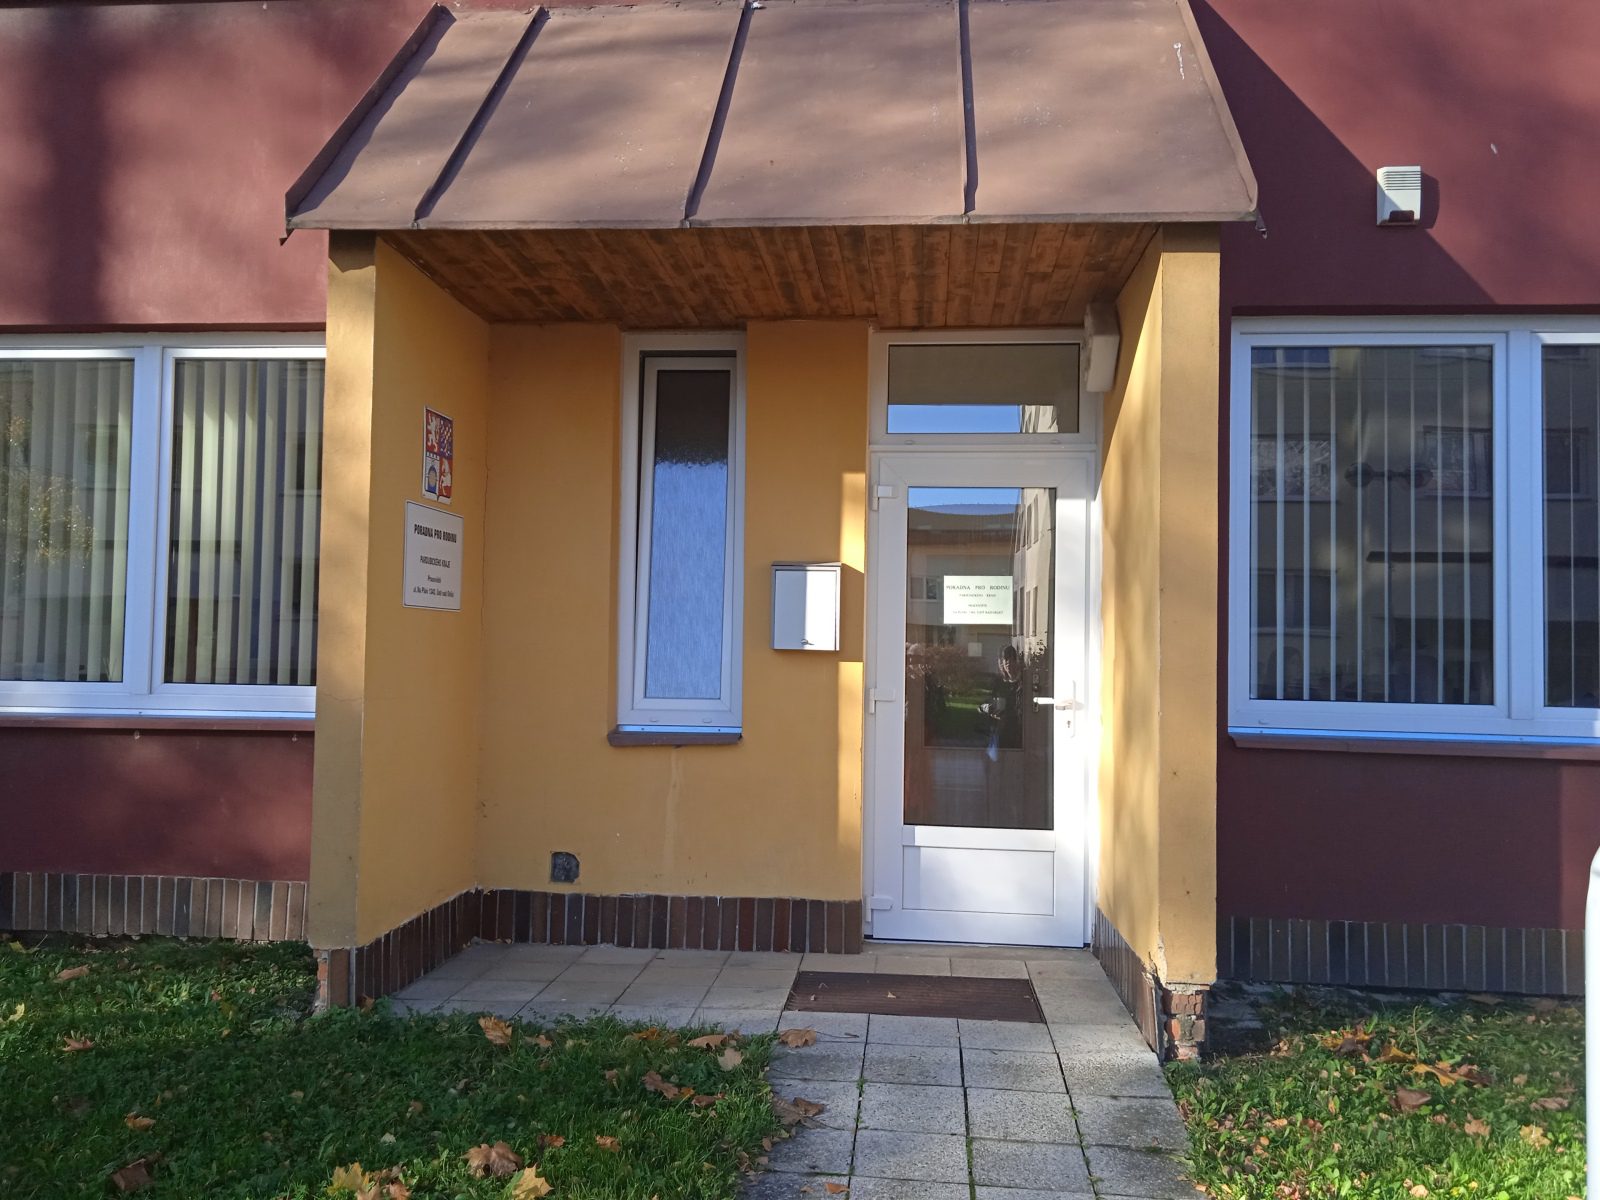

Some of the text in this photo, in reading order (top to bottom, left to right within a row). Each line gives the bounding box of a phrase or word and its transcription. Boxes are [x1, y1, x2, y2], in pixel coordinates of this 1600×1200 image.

[414, 524, 457, 543] PORADNA PRO RODINU
